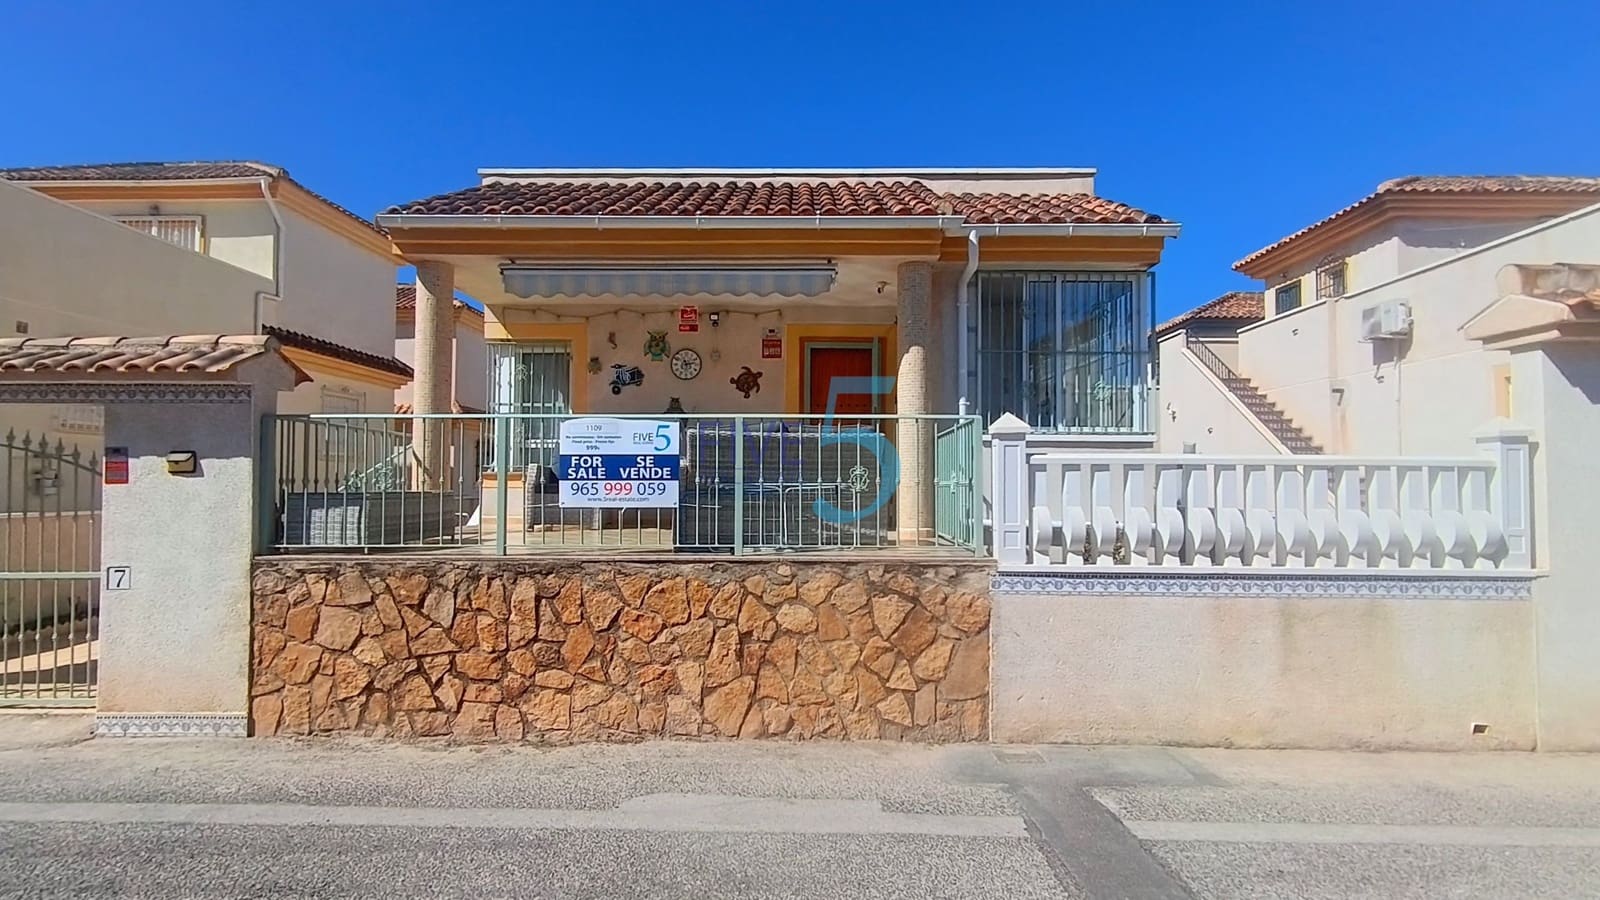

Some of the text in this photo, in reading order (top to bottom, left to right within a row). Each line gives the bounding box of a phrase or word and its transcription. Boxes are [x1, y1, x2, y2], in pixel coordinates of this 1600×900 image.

[633, 424, 671, 452] FIVE 5
[571, 456, 602, 467] FOR
[636, 456, 654, 467] SE
[567, 468, 606, 479] SALE
[620, 468, 671, 479] VENDE
[570, 482, 666, 496] 965 999 059
[114, 569, 127, 588] 7
